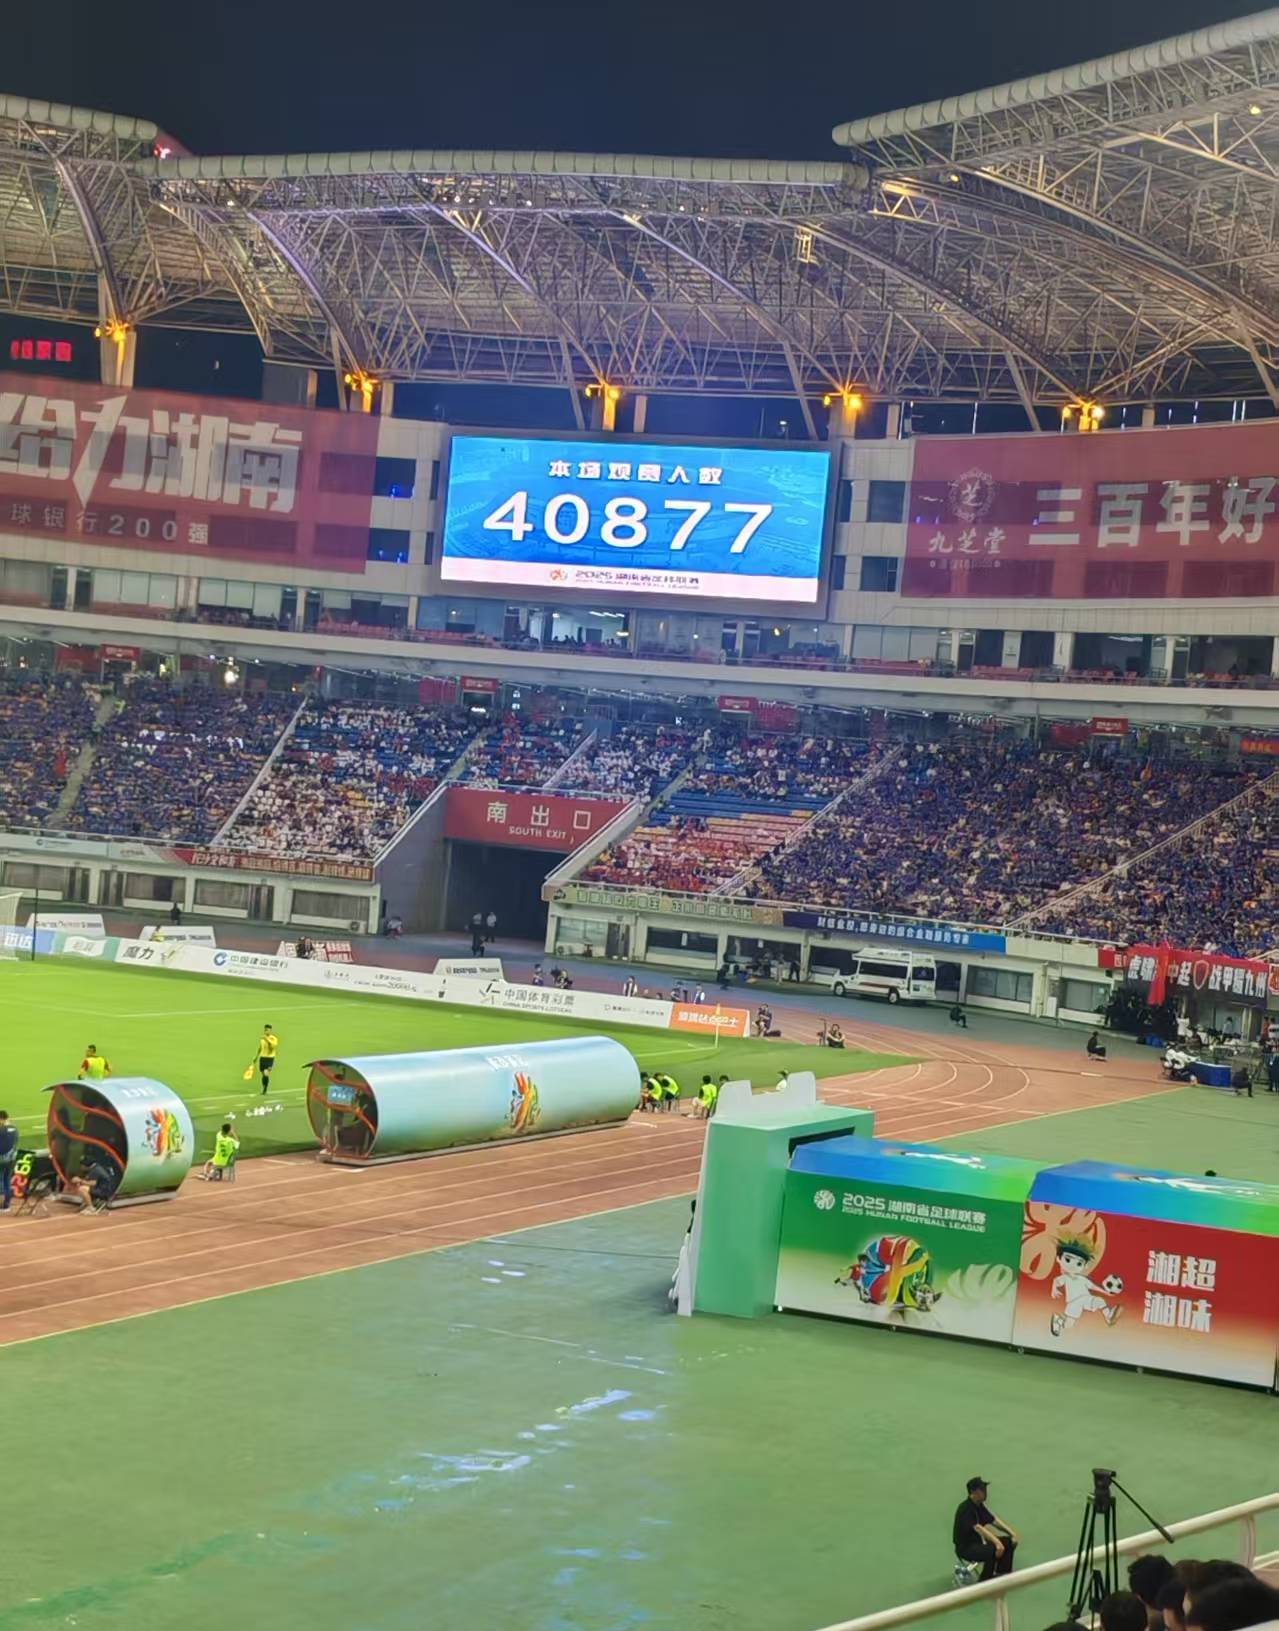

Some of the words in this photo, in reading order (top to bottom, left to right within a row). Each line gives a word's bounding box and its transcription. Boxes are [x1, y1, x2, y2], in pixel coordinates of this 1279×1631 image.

[482, 490, 774, 554] 40877
[1028, 474, 1278, 547] 三百年好
[486, 801, 591, 830] 南出口
[508, 825, 542, 838] SOUTH
[546, 829, 567, 840] EXIT
[842, 1192, 886, 1211] 2025
[888, 1199, 987, 1226] 湖南省足球联赛
[900, 1214, 947, 1229] FOOTBALL
[949, 1221, 987, 1234] LEAGUE
[1146, 1249, 1217, 1292] 湘超
[1143, 1289, 1212, 1333] 湘味
